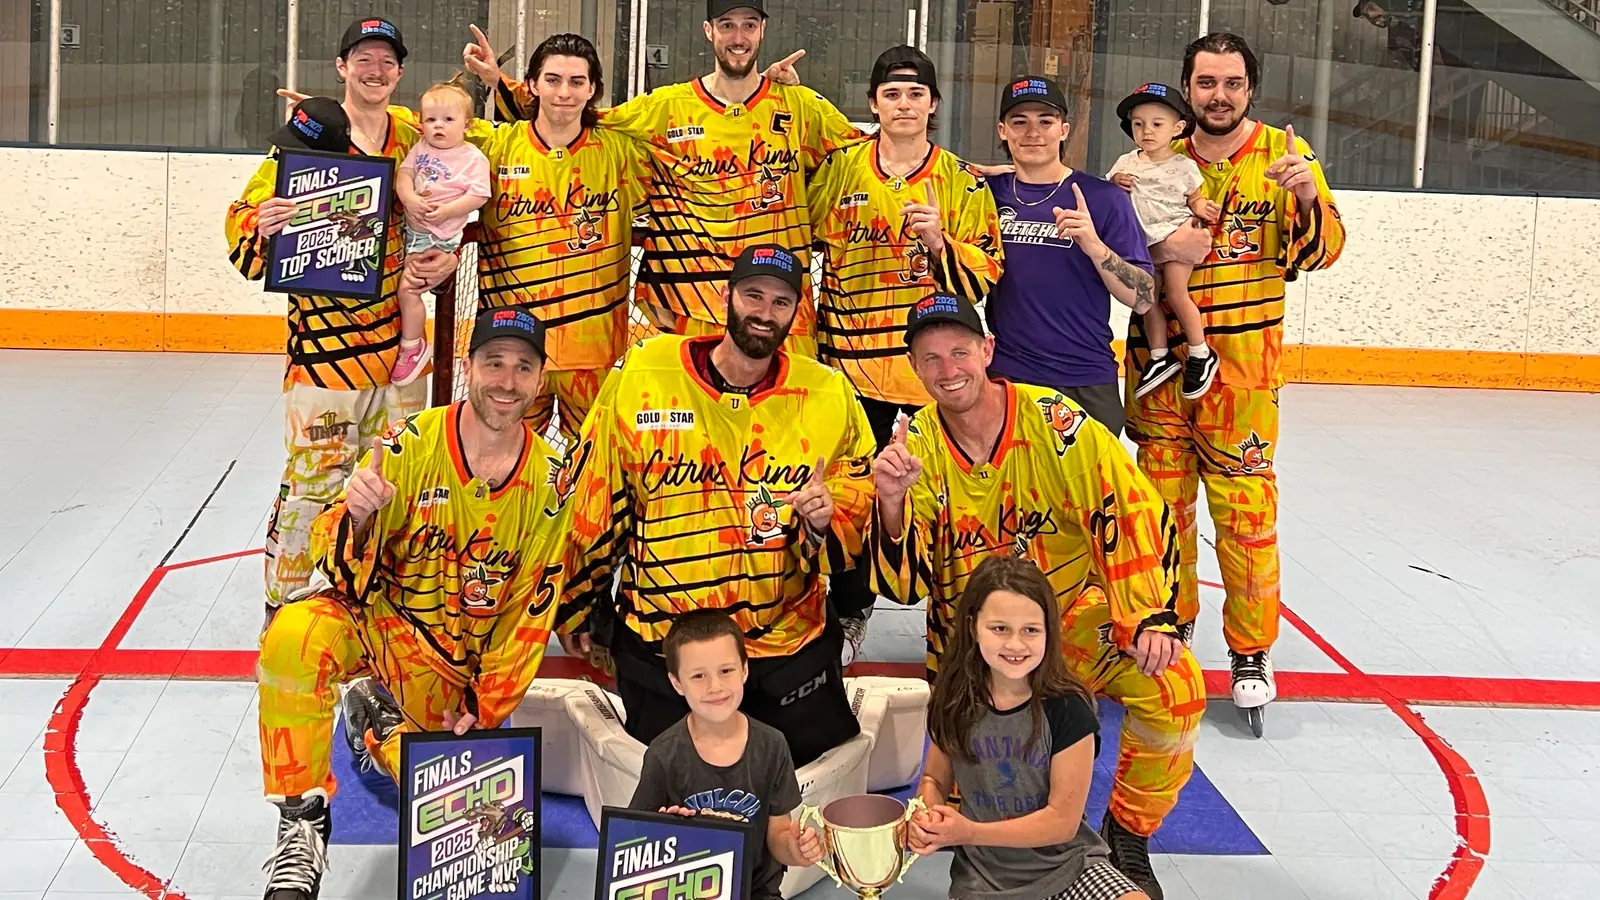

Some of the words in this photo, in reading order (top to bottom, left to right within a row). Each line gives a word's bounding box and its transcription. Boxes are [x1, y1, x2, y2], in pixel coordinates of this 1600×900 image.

[63, 28, 73, 43] 3
[667, 129, 684, 139] GOLD
[687, 126, 705, 136] STAR
[747, 139, 800, 175] Kings
[287, 166, 339, 196] FINALS
[290, 185, 373, 227] ECHO
[495, 192, 556, 223] Citrus
[564, 182, 620, 217] Kings
[300, 228, 333, 251] 2025
[999, 214, 1070, 240] FLETCHE
[280, 252, 312, 279] TOP
[315, 236, 375, 269] SCORER
[774, 249, 793, 265] 2025
[935, 295, 957, 305] 2025
[636, 412, 660, 424] GOLD
[670, 411, 695, 423] STAR
[731, 398, 740, 409] U
[642, 448, 727, 495] Citrus
[528, 563, 564, 617] 5
[780, 669, 827, 706] CCM
[413, 750, 472, 796] FINALS
[418, 769, 515, 834] ECHO
[434, 828, 473, 863] 2025
[612, 836, 678, 879] FINALS
